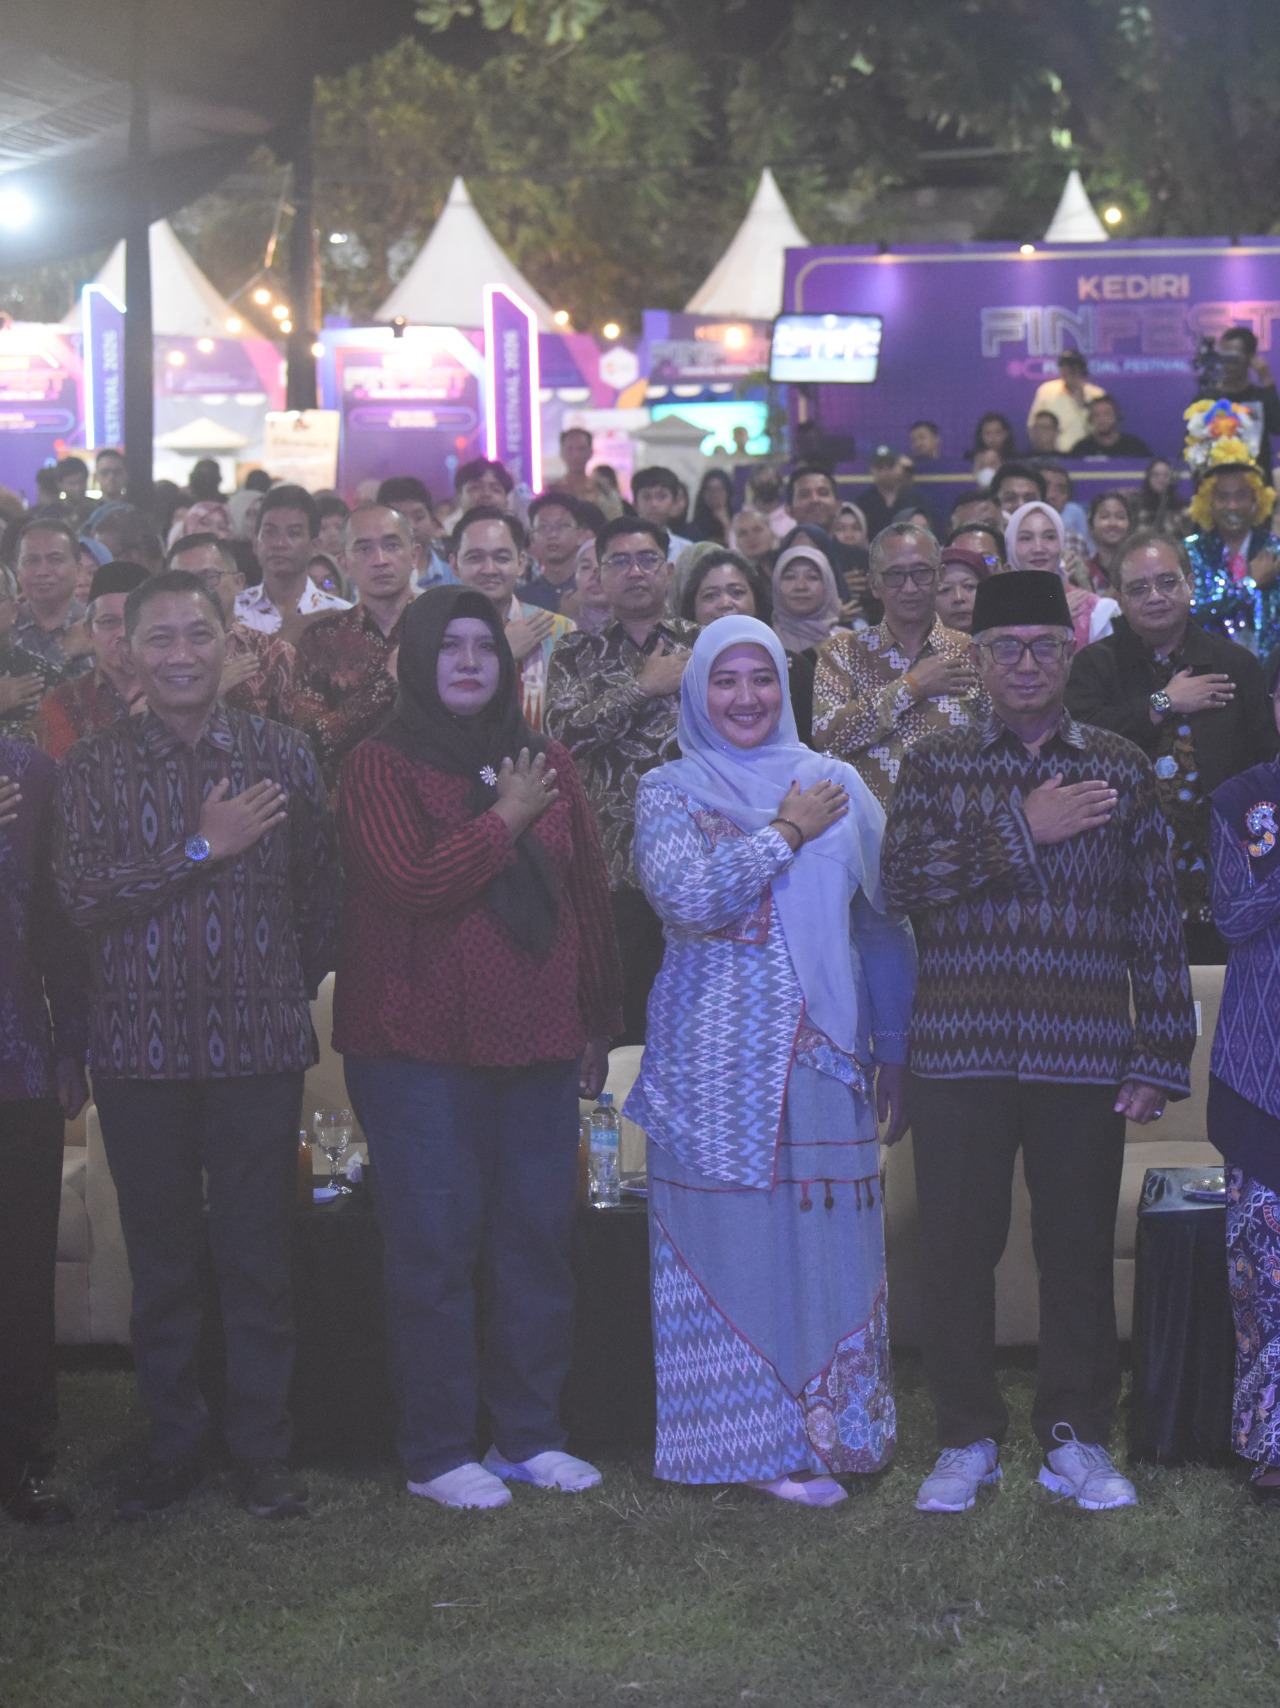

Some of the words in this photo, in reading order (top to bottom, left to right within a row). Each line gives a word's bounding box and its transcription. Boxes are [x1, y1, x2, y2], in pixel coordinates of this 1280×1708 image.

[1077, 274, 1190, 300] KEDIRI
[1123, 358, 1191, 373] FESTIVAL
[104, 374, 121, 447] ESTIVAL
